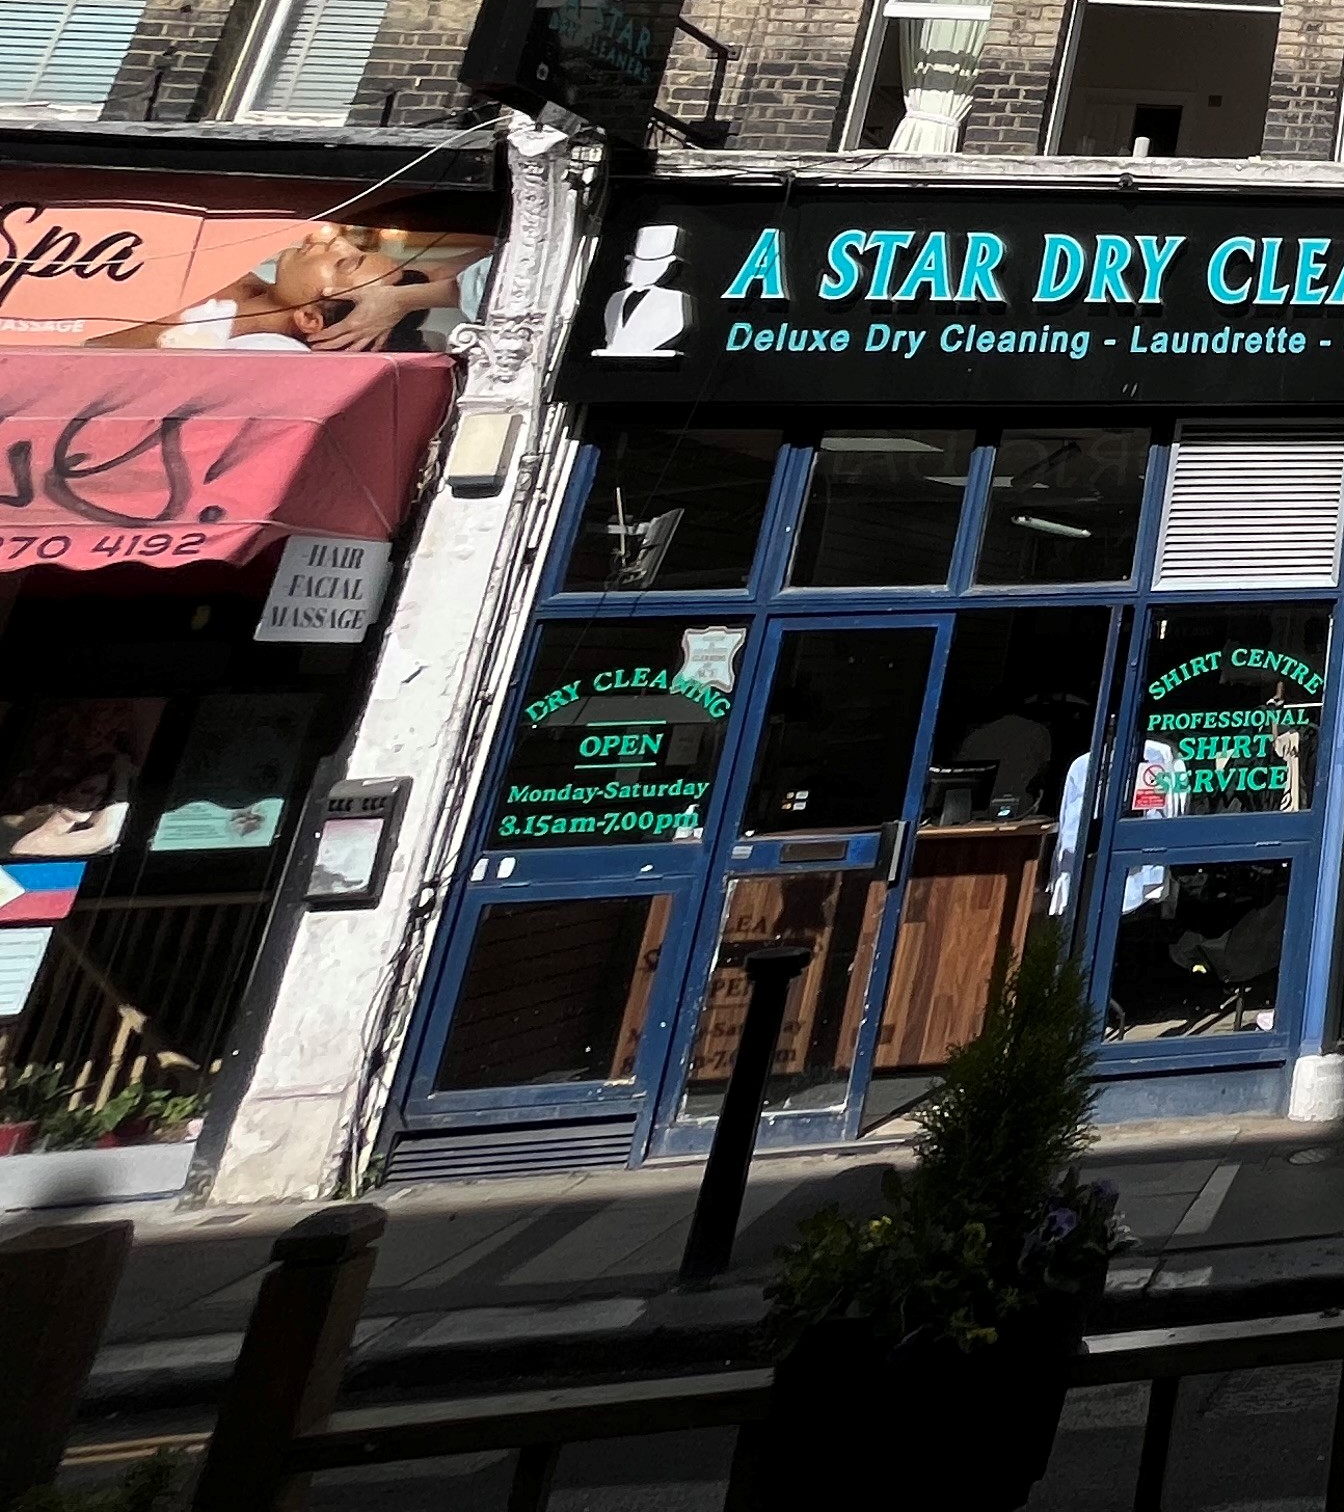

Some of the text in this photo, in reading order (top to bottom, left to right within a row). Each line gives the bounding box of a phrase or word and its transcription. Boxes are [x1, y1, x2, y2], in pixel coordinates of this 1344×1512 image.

[721, 227, 788, 301] A
[818, 228, 1007, 304] STAR
[1032, 233, 1186, 305] DRY
[0, 319, 86, 333] ASSAGE
[725, 321, 851, 353] Deluxe
[864, 323, 926, 360] Dry
[939, 322, 1090, 361] Cleaning
[1130, 325, 1307, 355] Laundrette
[0, 533, 207, 560] 70 4192
[1148, 648, 1324, 701] SHIRT CENTRE
[524, 679, 582, 723] DRY
[1146, 708, 1310, 731] PROFESSIONAL
[578, 733, 664, 758] OPEN
[1178, 733, 1275, 762] SHIRT
[506, 778, 711, 805] Monday-Saturday
[1154, 765, 1290, 794] SERVICE
